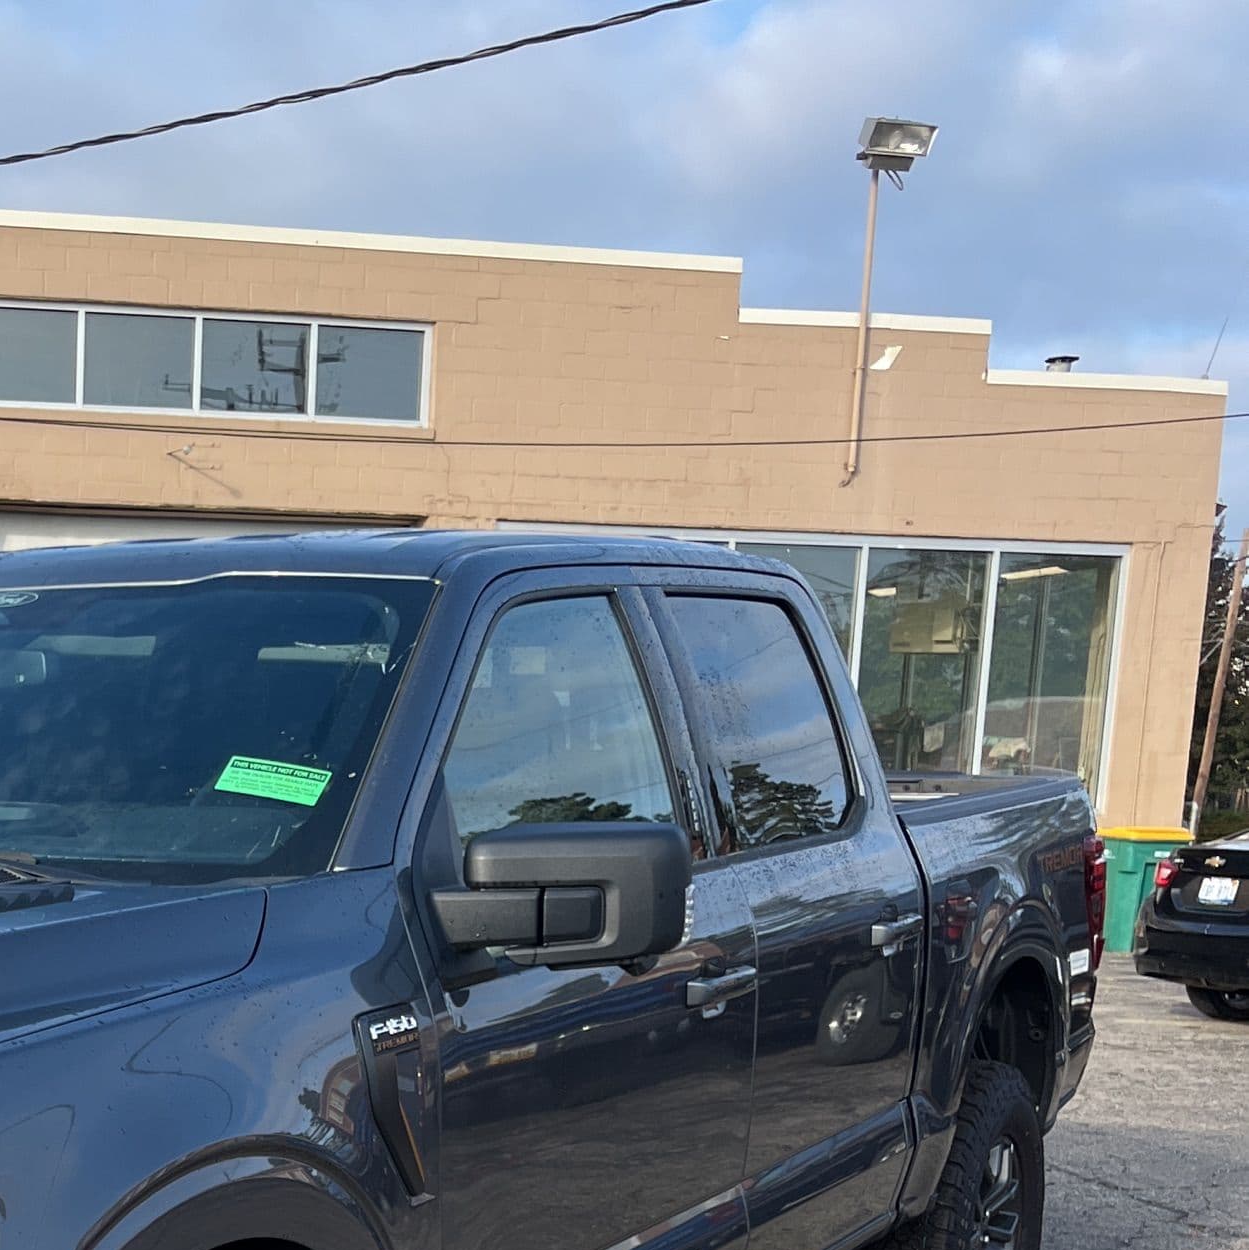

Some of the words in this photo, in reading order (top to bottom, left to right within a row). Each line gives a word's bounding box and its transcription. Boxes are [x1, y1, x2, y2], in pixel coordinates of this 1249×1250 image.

[234, 761, 249, 769] THIS
[250, 763, 277, 773] VEHICLE
[277, 767, 293, 776] NOT
[294, 770, 309, 778] FOR
[309, 773, 326, 781] SALE
[369, 1015, 418, 1040] F-150
